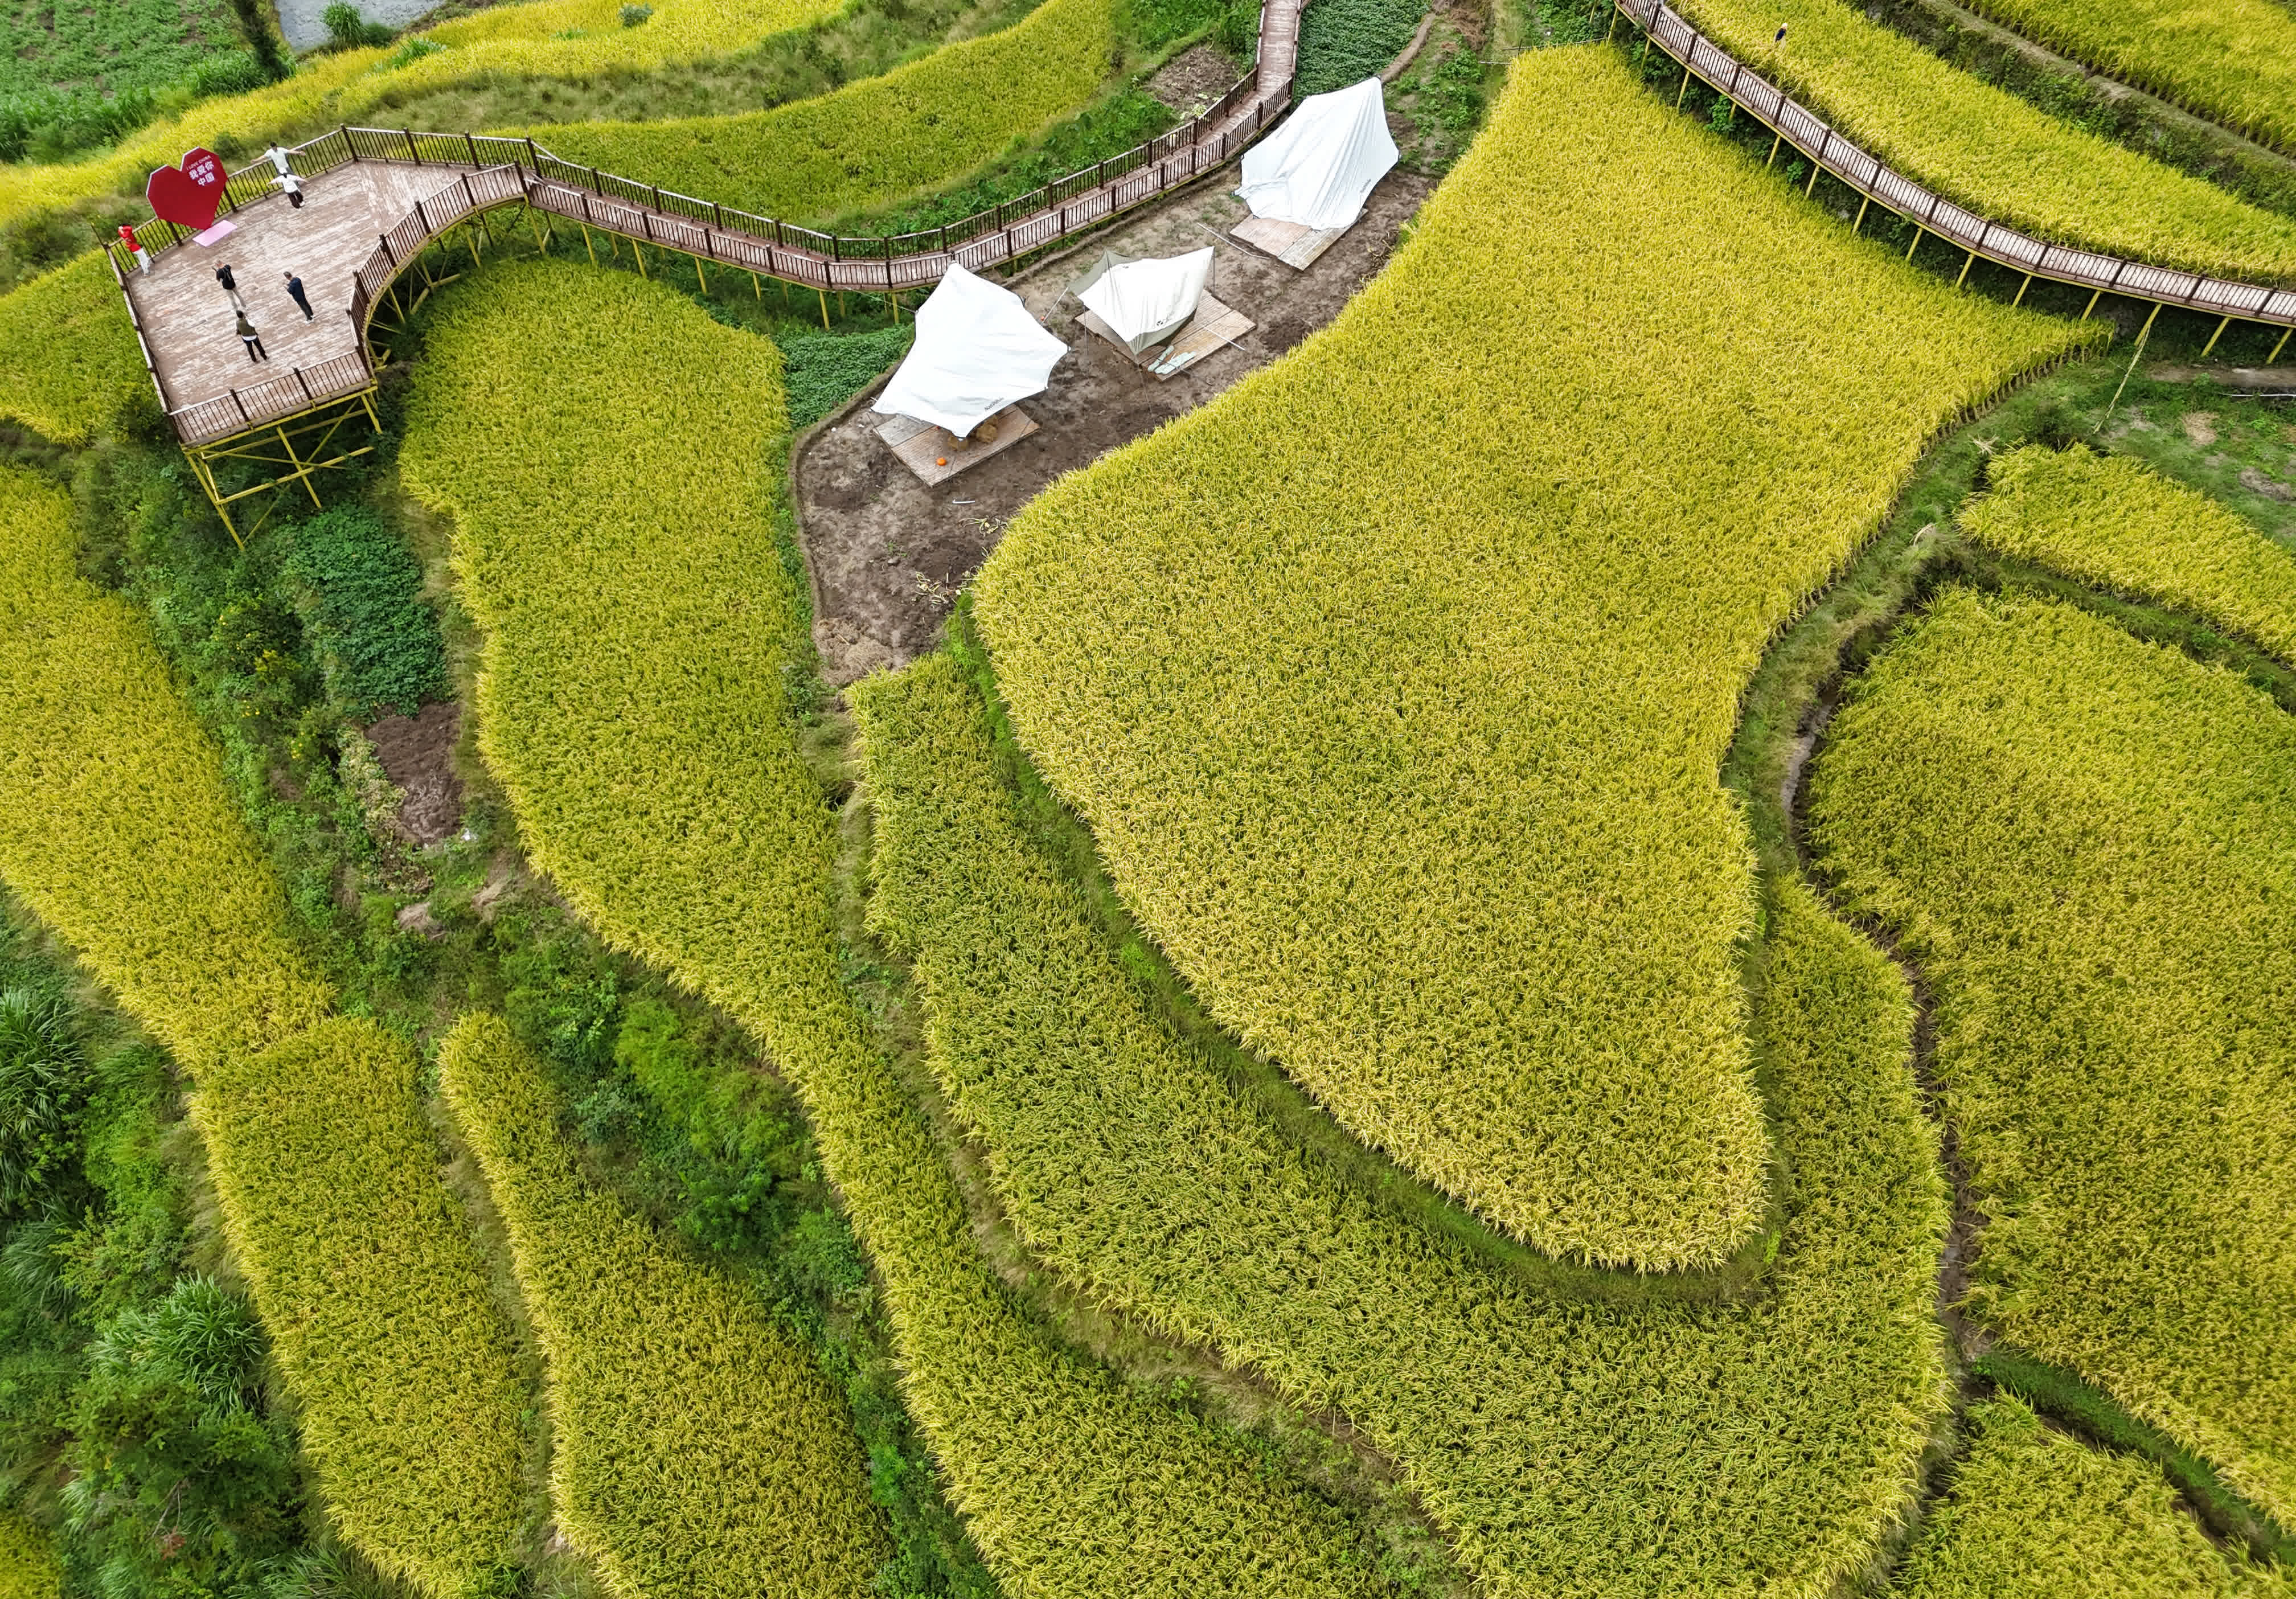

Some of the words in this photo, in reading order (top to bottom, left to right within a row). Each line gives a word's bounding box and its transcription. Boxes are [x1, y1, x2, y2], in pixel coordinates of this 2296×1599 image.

[188, 161, 199, 170] LOVE
[188, 161, 214, 179] 我爱你
[197, 172, 215, 186] 中国
